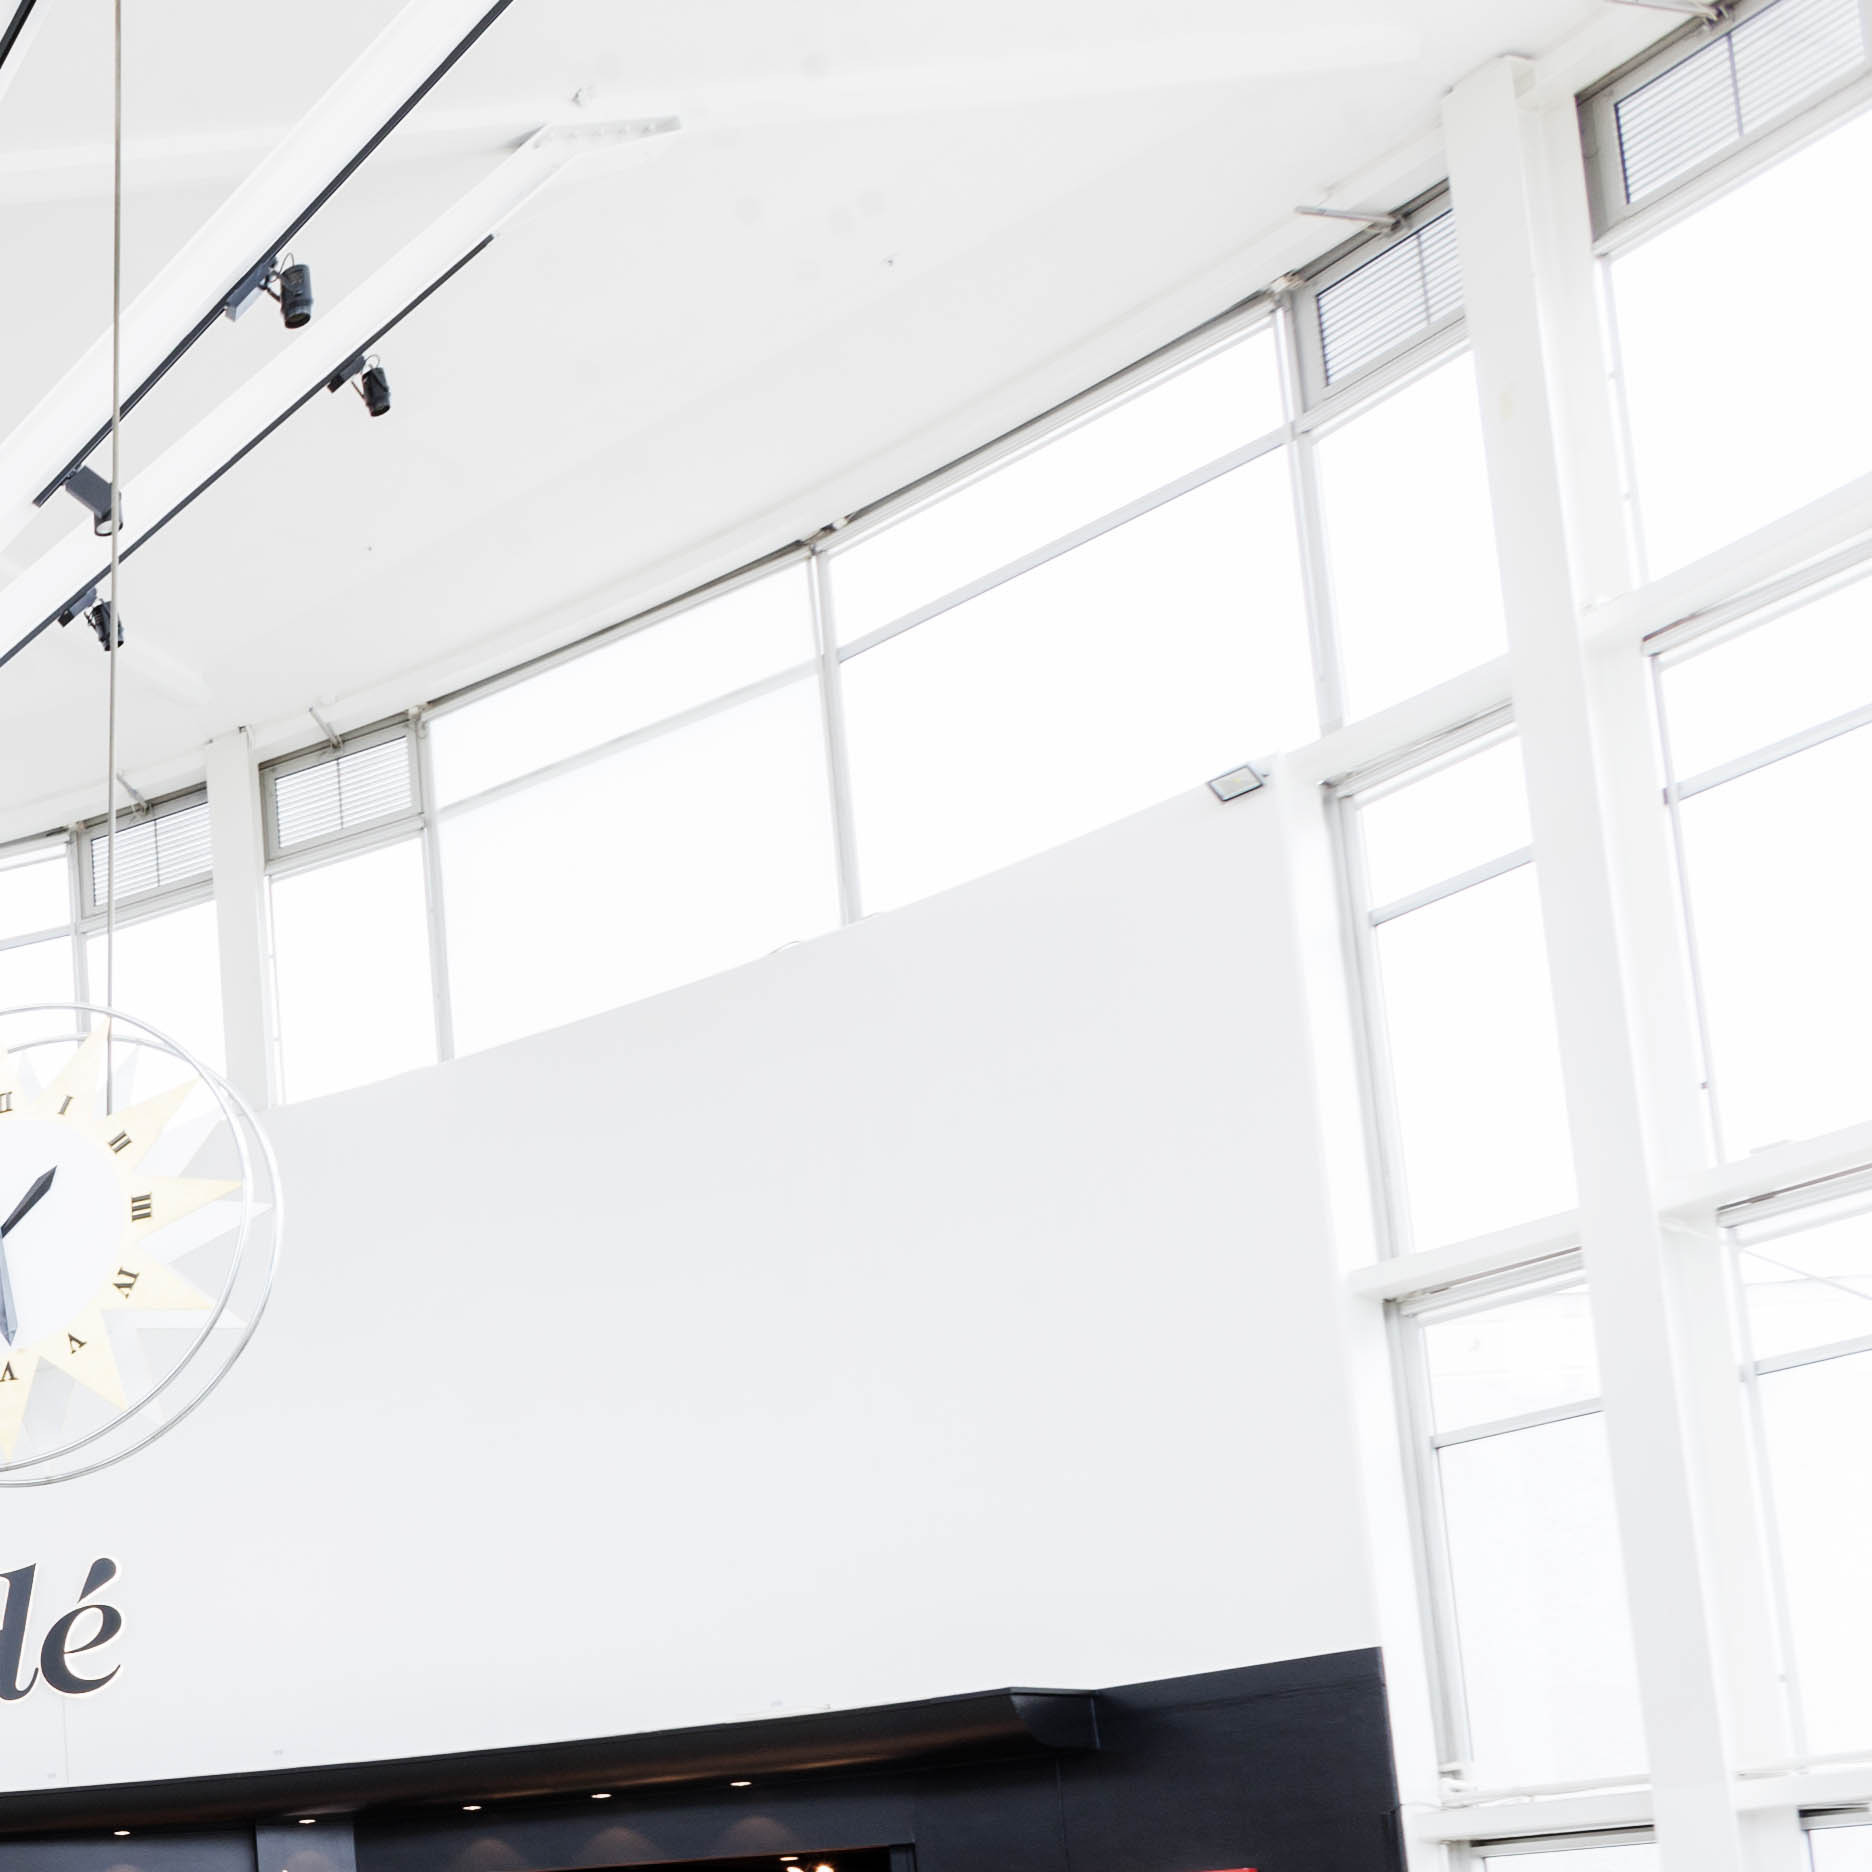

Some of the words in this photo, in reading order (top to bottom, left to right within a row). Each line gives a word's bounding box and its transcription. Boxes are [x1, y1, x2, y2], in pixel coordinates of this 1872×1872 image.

[57, 1095, 74, 1115] I
[107, 1129, 133, 1154] II
[131, 1192, 152, 1222] III
[67, 1332, 87, 1354] V
